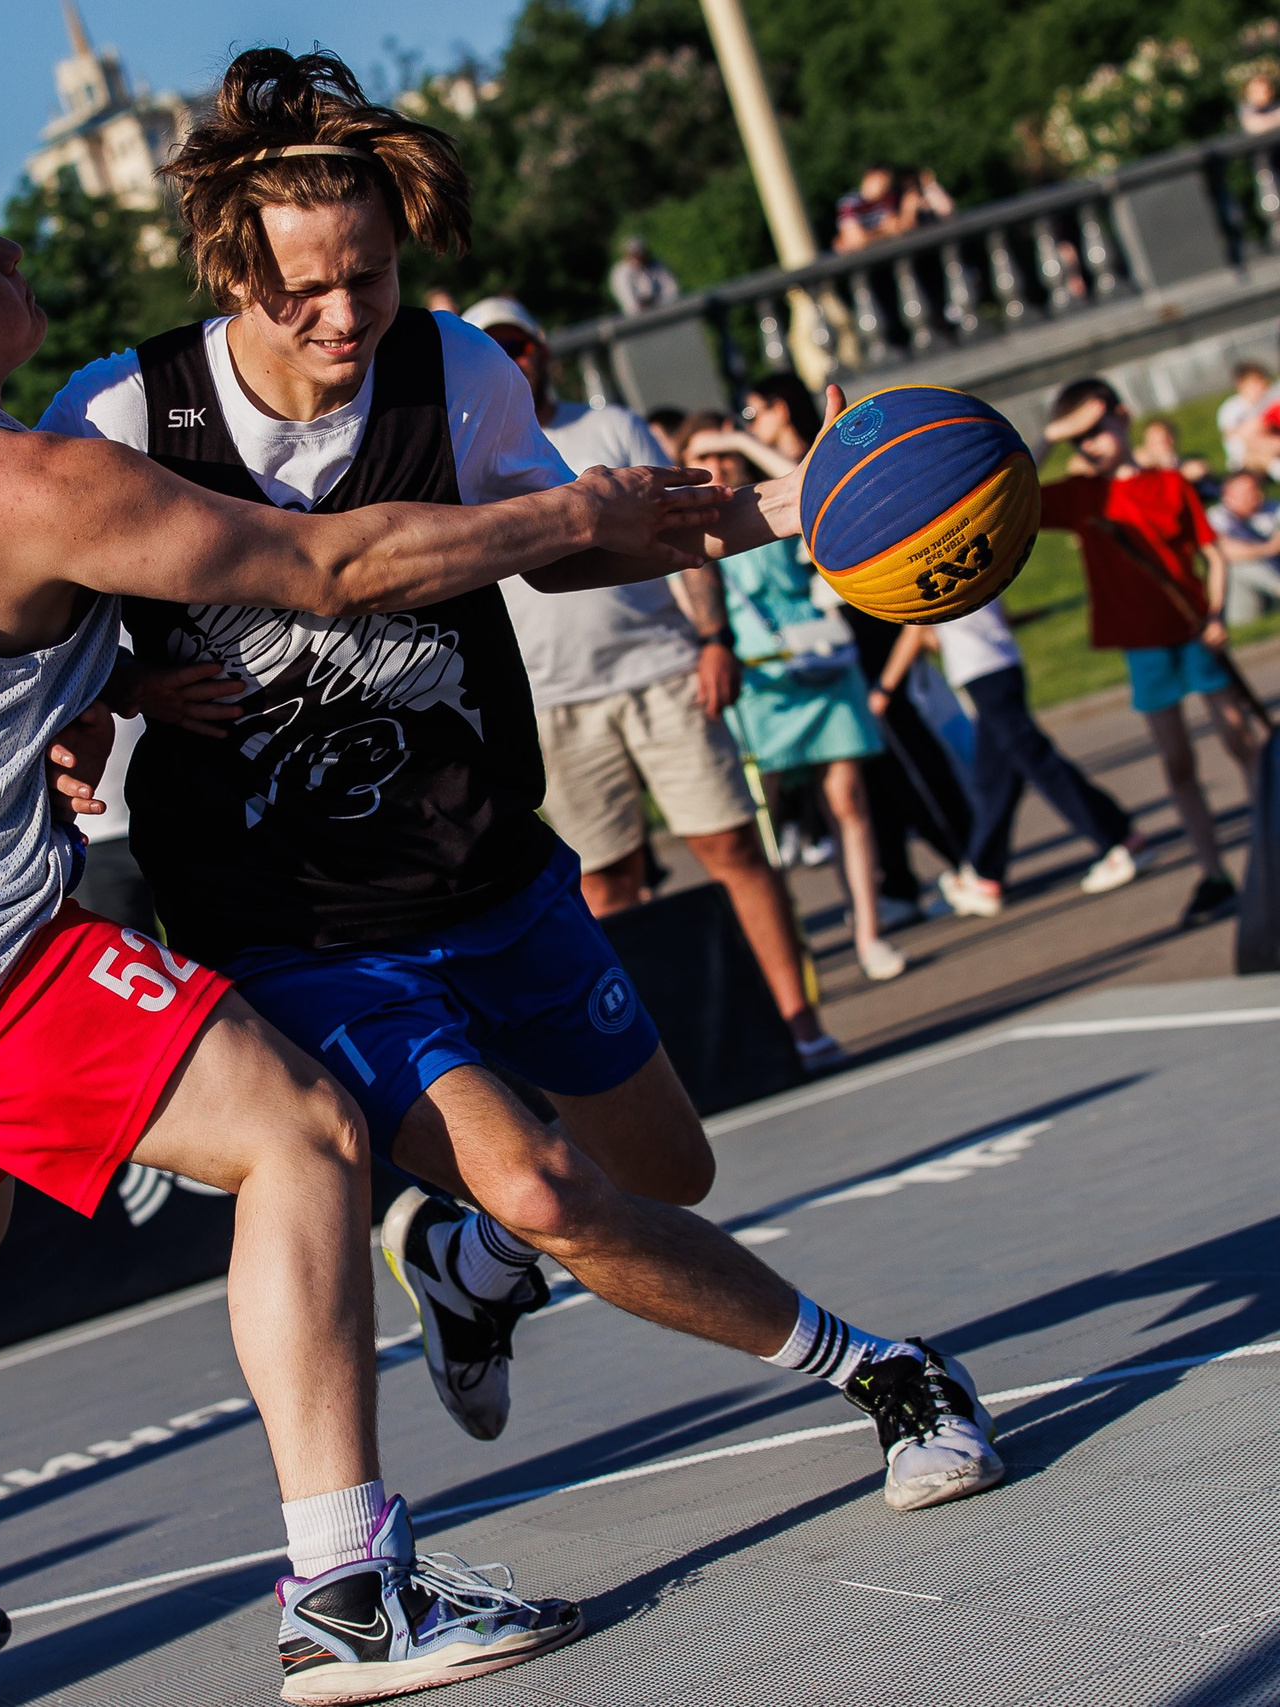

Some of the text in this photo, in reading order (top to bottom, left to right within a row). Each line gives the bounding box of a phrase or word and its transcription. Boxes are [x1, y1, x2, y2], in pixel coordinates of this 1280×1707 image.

[167, 407, 207, 428] STK
[906, 517, 970, 563] OFFICIAL BALL
[945, 534, 966, 553] FIBA
[88, 928, 200, 1012] 52
